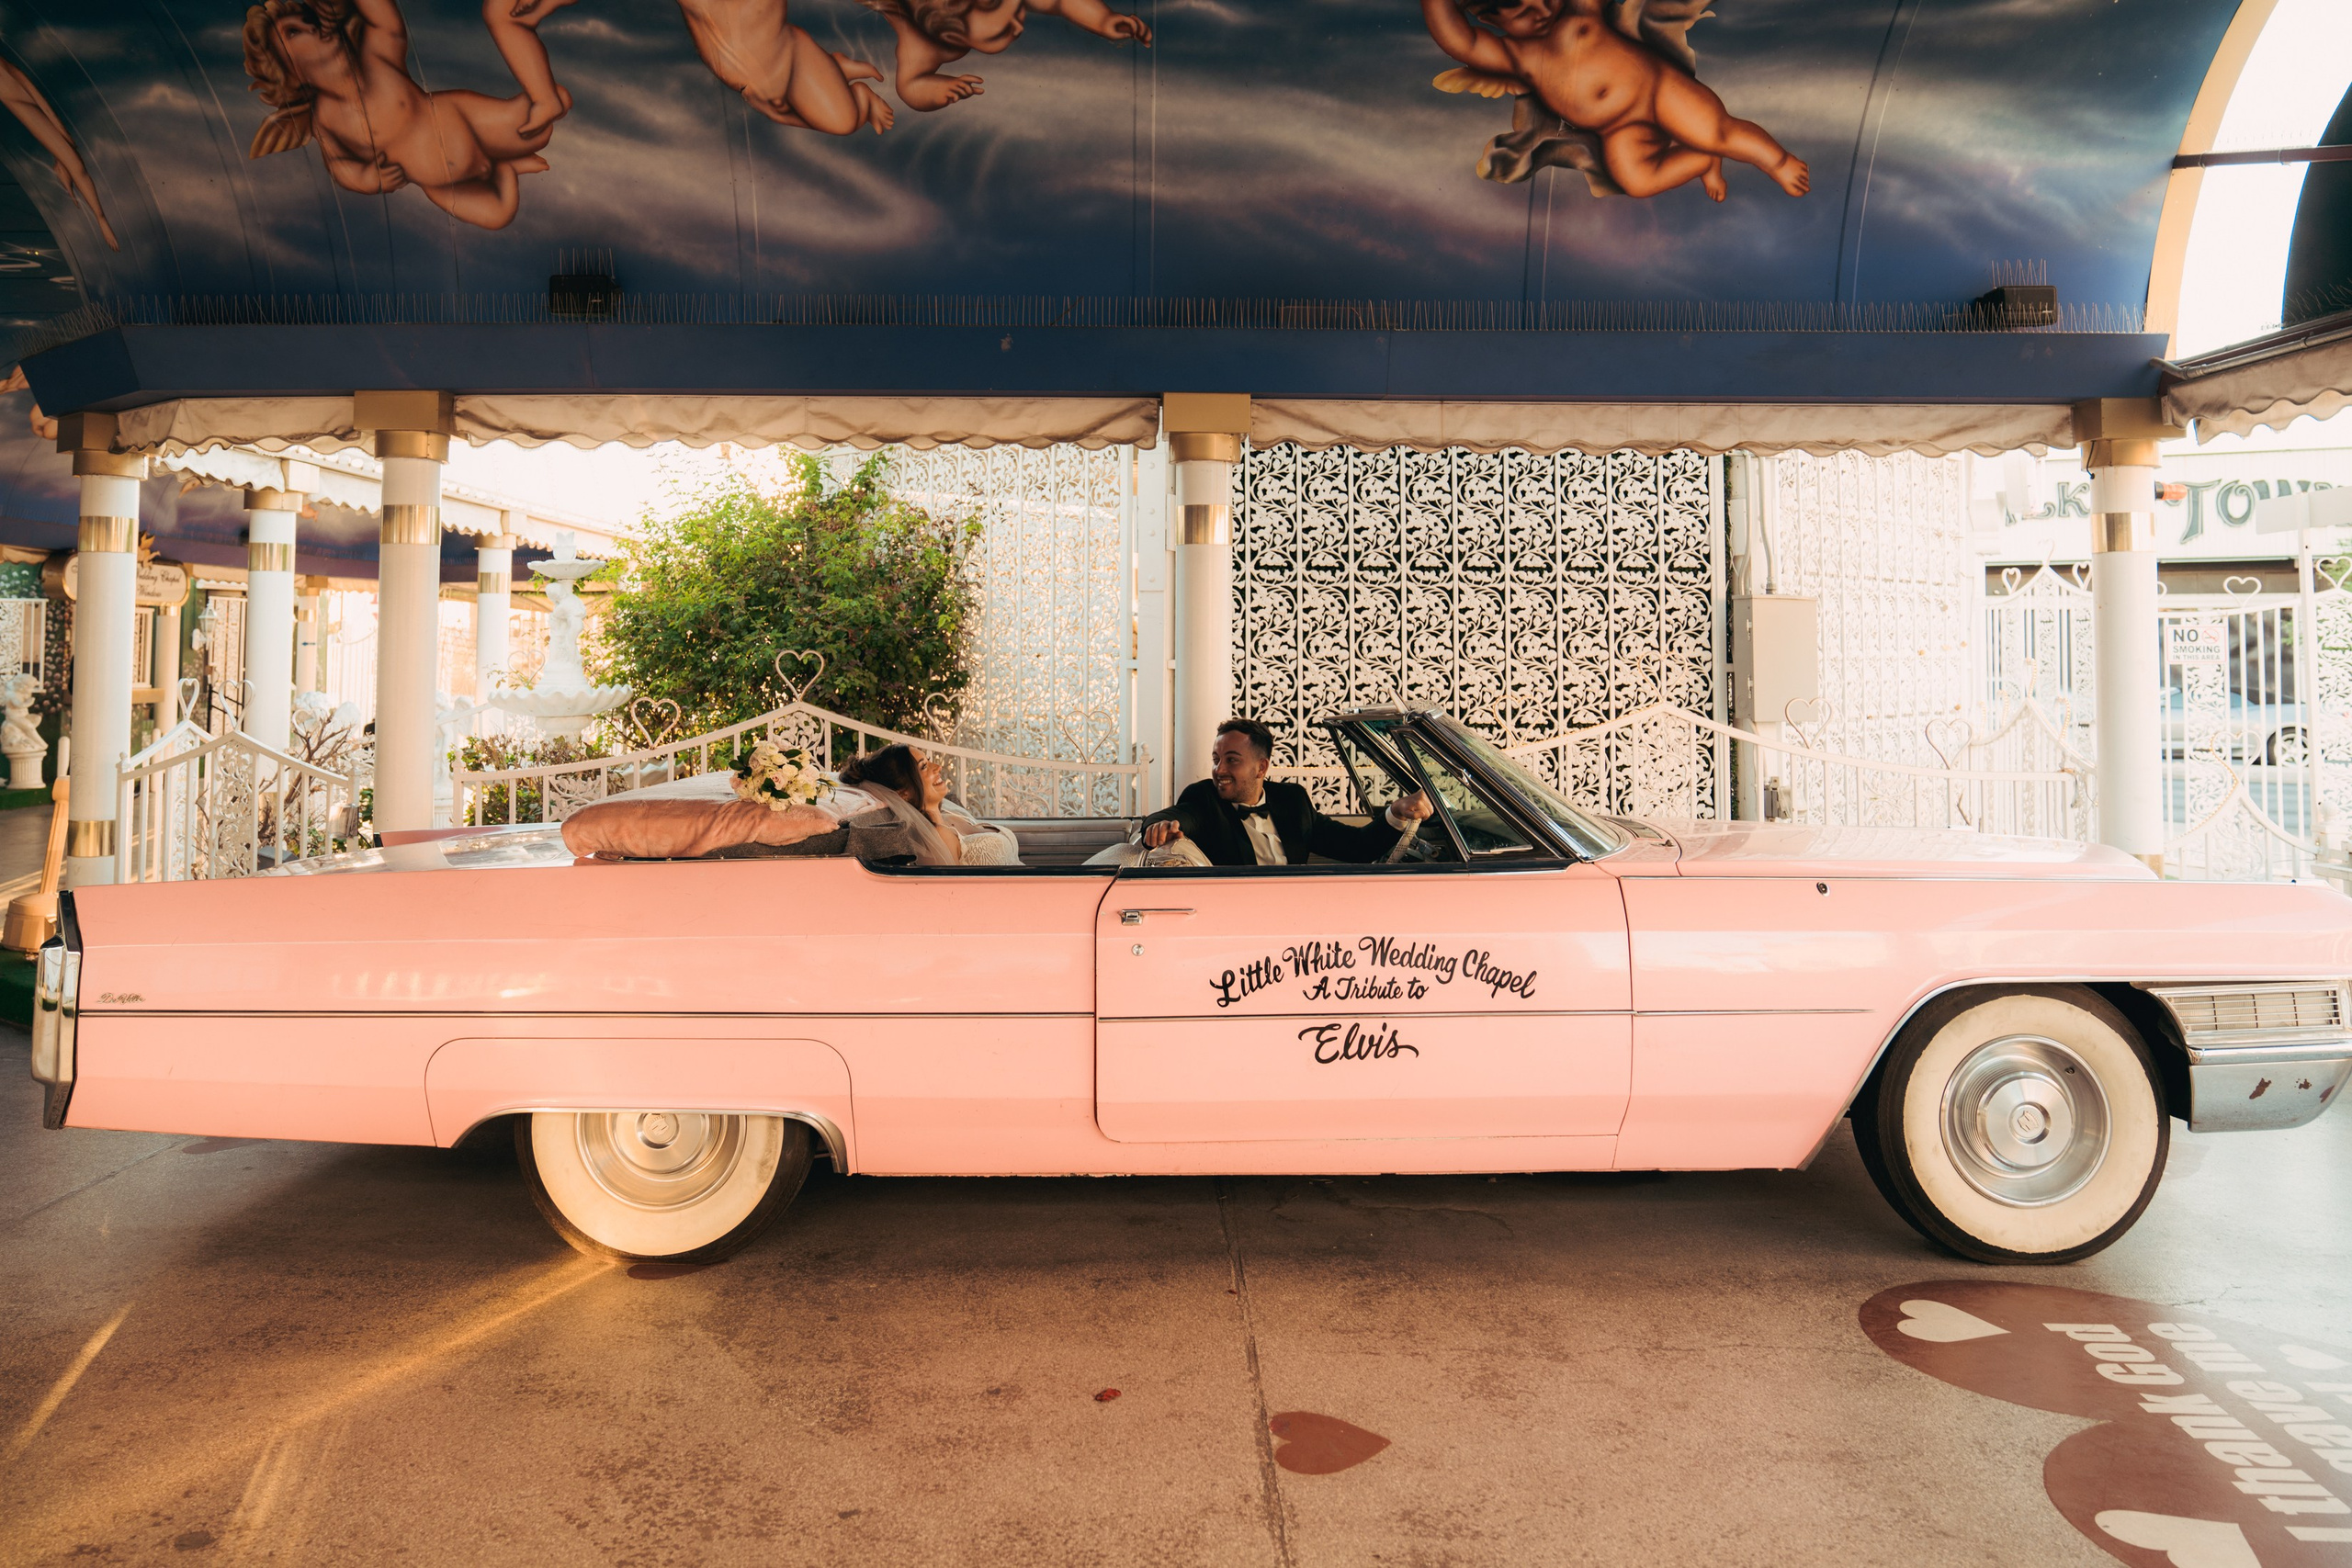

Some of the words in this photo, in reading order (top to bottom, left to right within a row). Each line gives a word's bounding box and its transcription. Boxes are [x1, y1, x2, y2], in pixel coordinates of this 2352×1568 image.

[2173, 645, 2221, 653] SMOKING
[2174, 629, 2199, 642] NO
[1210, 956, 1285, 1008] Little
[1282, 941, 1356, 978] White
[1359, 936, 1458, 985] Wedding
[1462, 949, 1538, 999] Chapel
[1302, 976, 1331, 1001] A
[1334, 976, 1404, 1000] Tribute
[1408, 976, 1430, 1000] to
[1298, 1022, 1419, 1065] Elvis
[2042, 1323, 2185, 1385] God
[2147, 1322, 2267, 1372] me
[2138, 1393, 2351, 1515] thank
